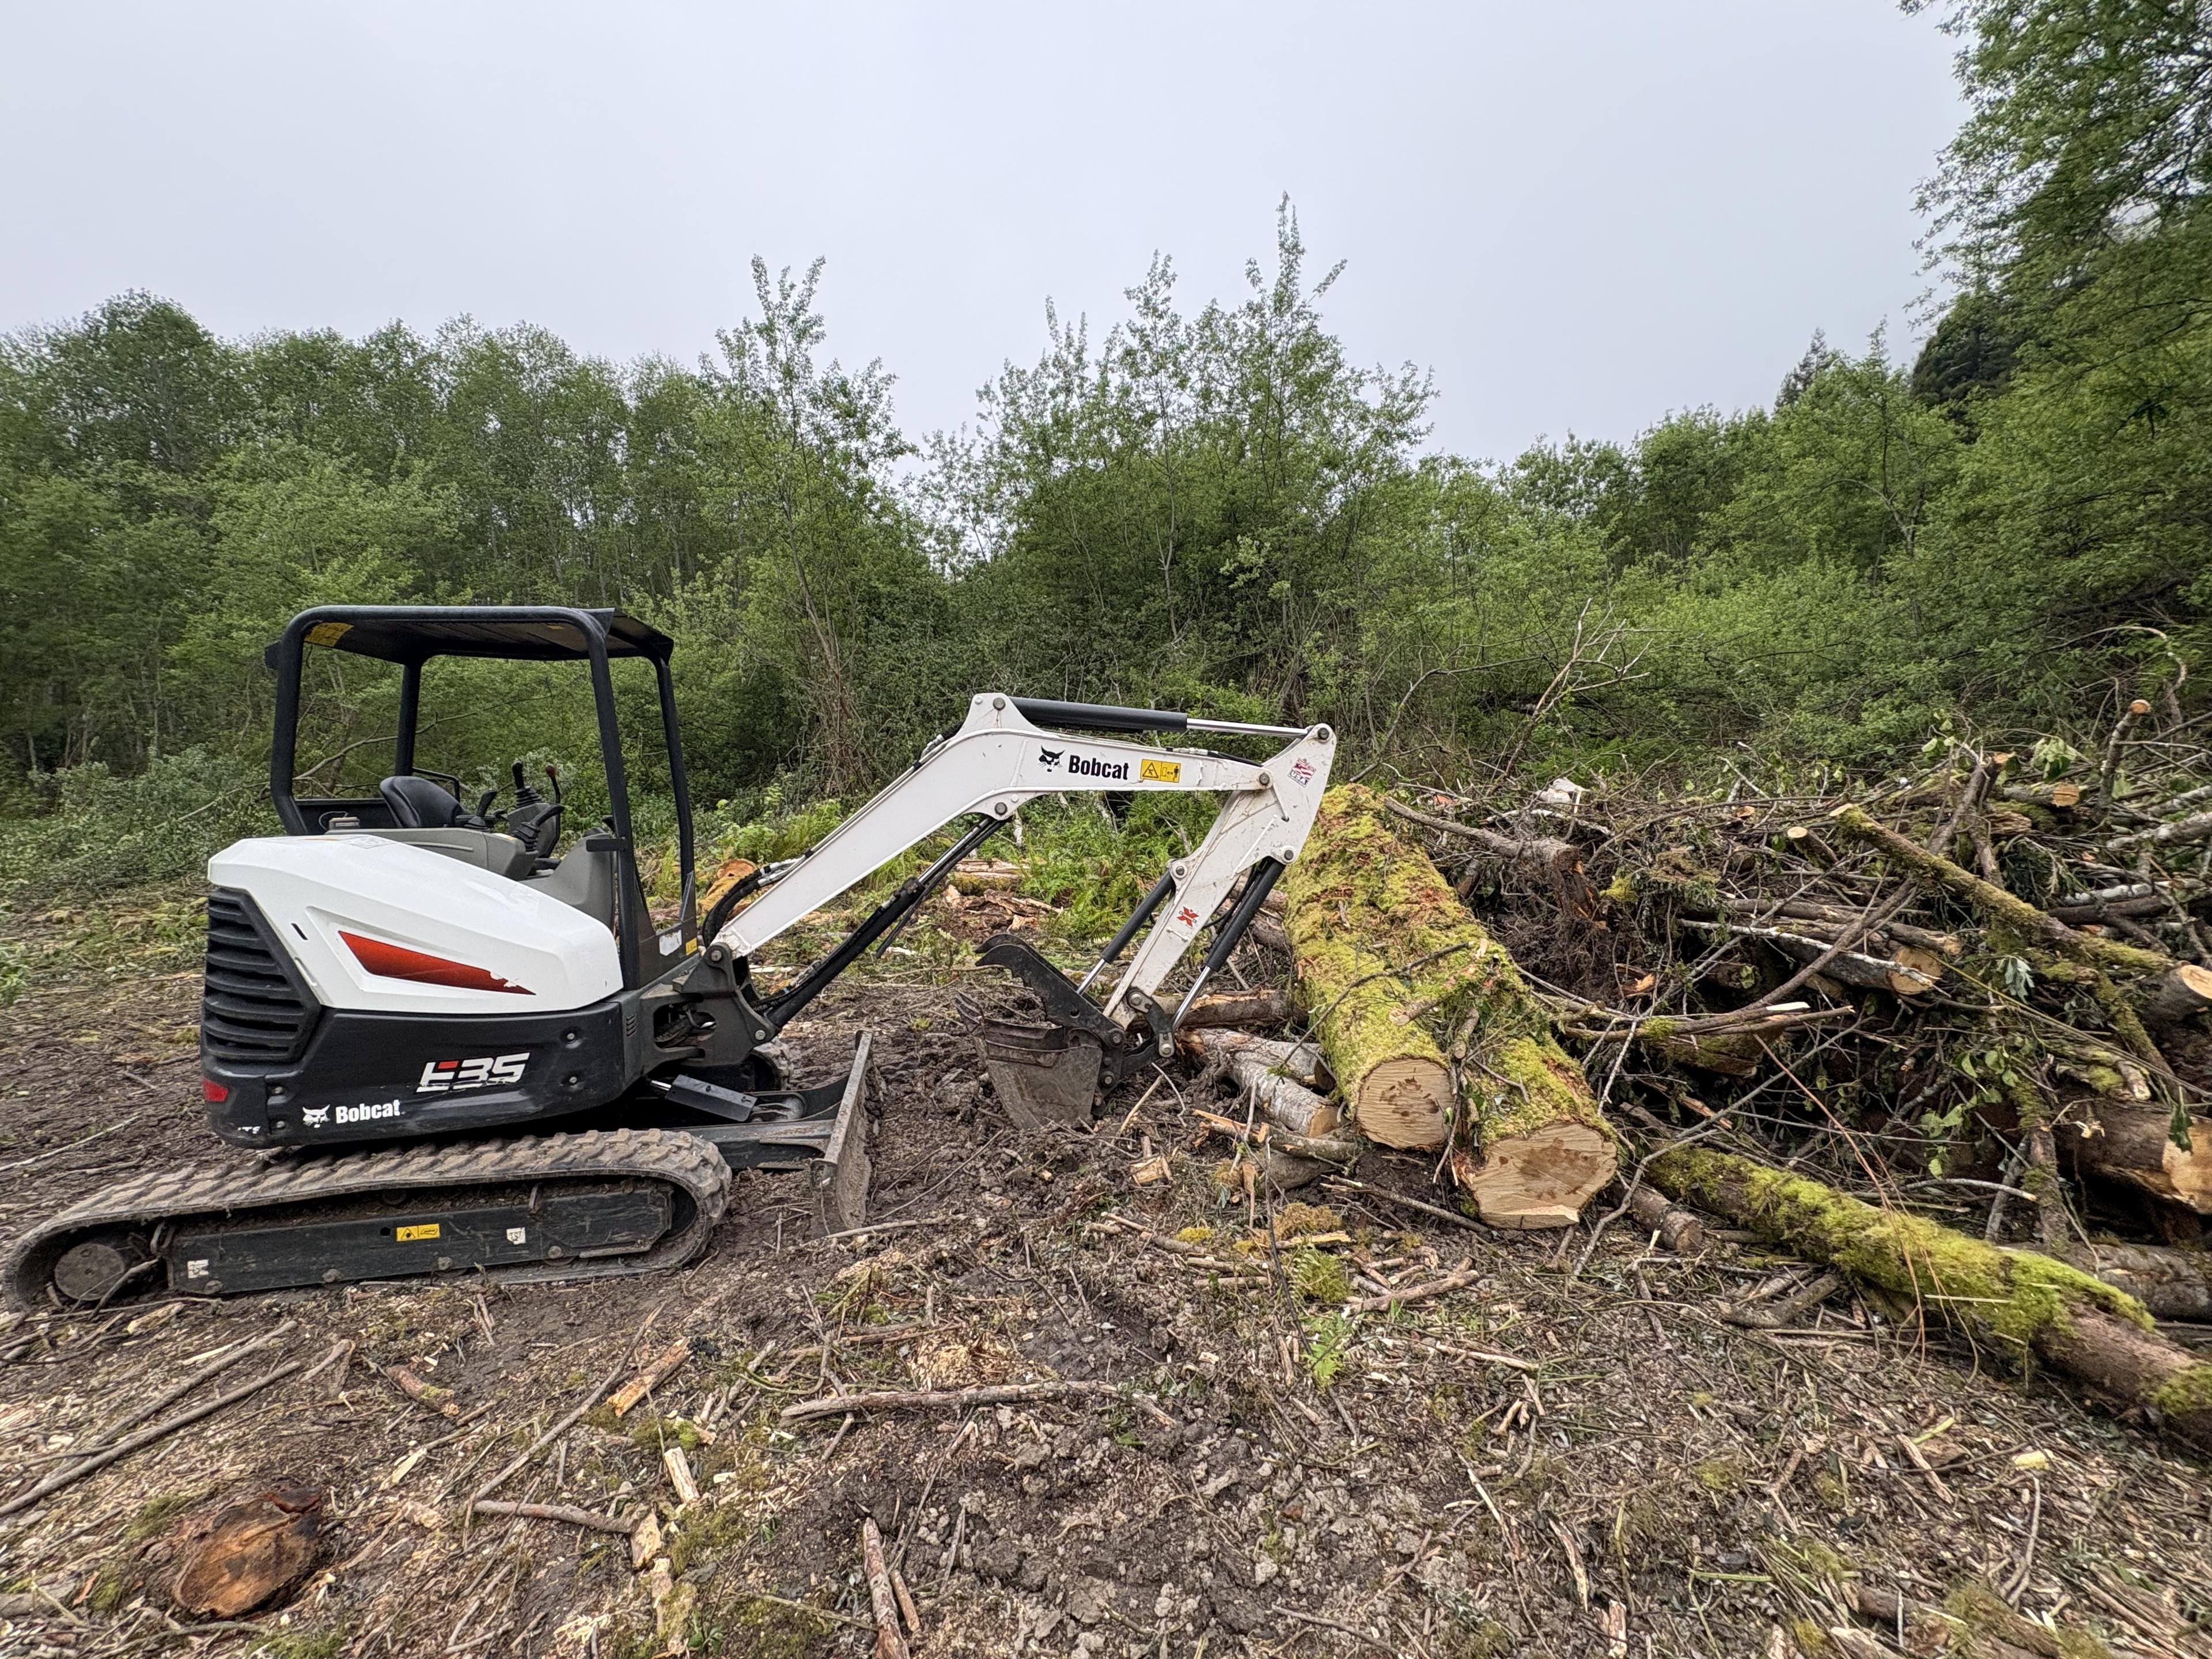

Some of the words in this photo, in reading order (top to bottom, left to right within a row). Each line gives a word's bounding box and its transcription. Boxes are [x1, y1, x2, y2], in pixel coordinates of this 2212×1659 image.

[1069, 755, 1129, 780] Bobcat
[1290, 770, 1307, 785] USA
[416, 1052, 530, 1093] E35
[336, 1099, 400, 1124] Bobcat
